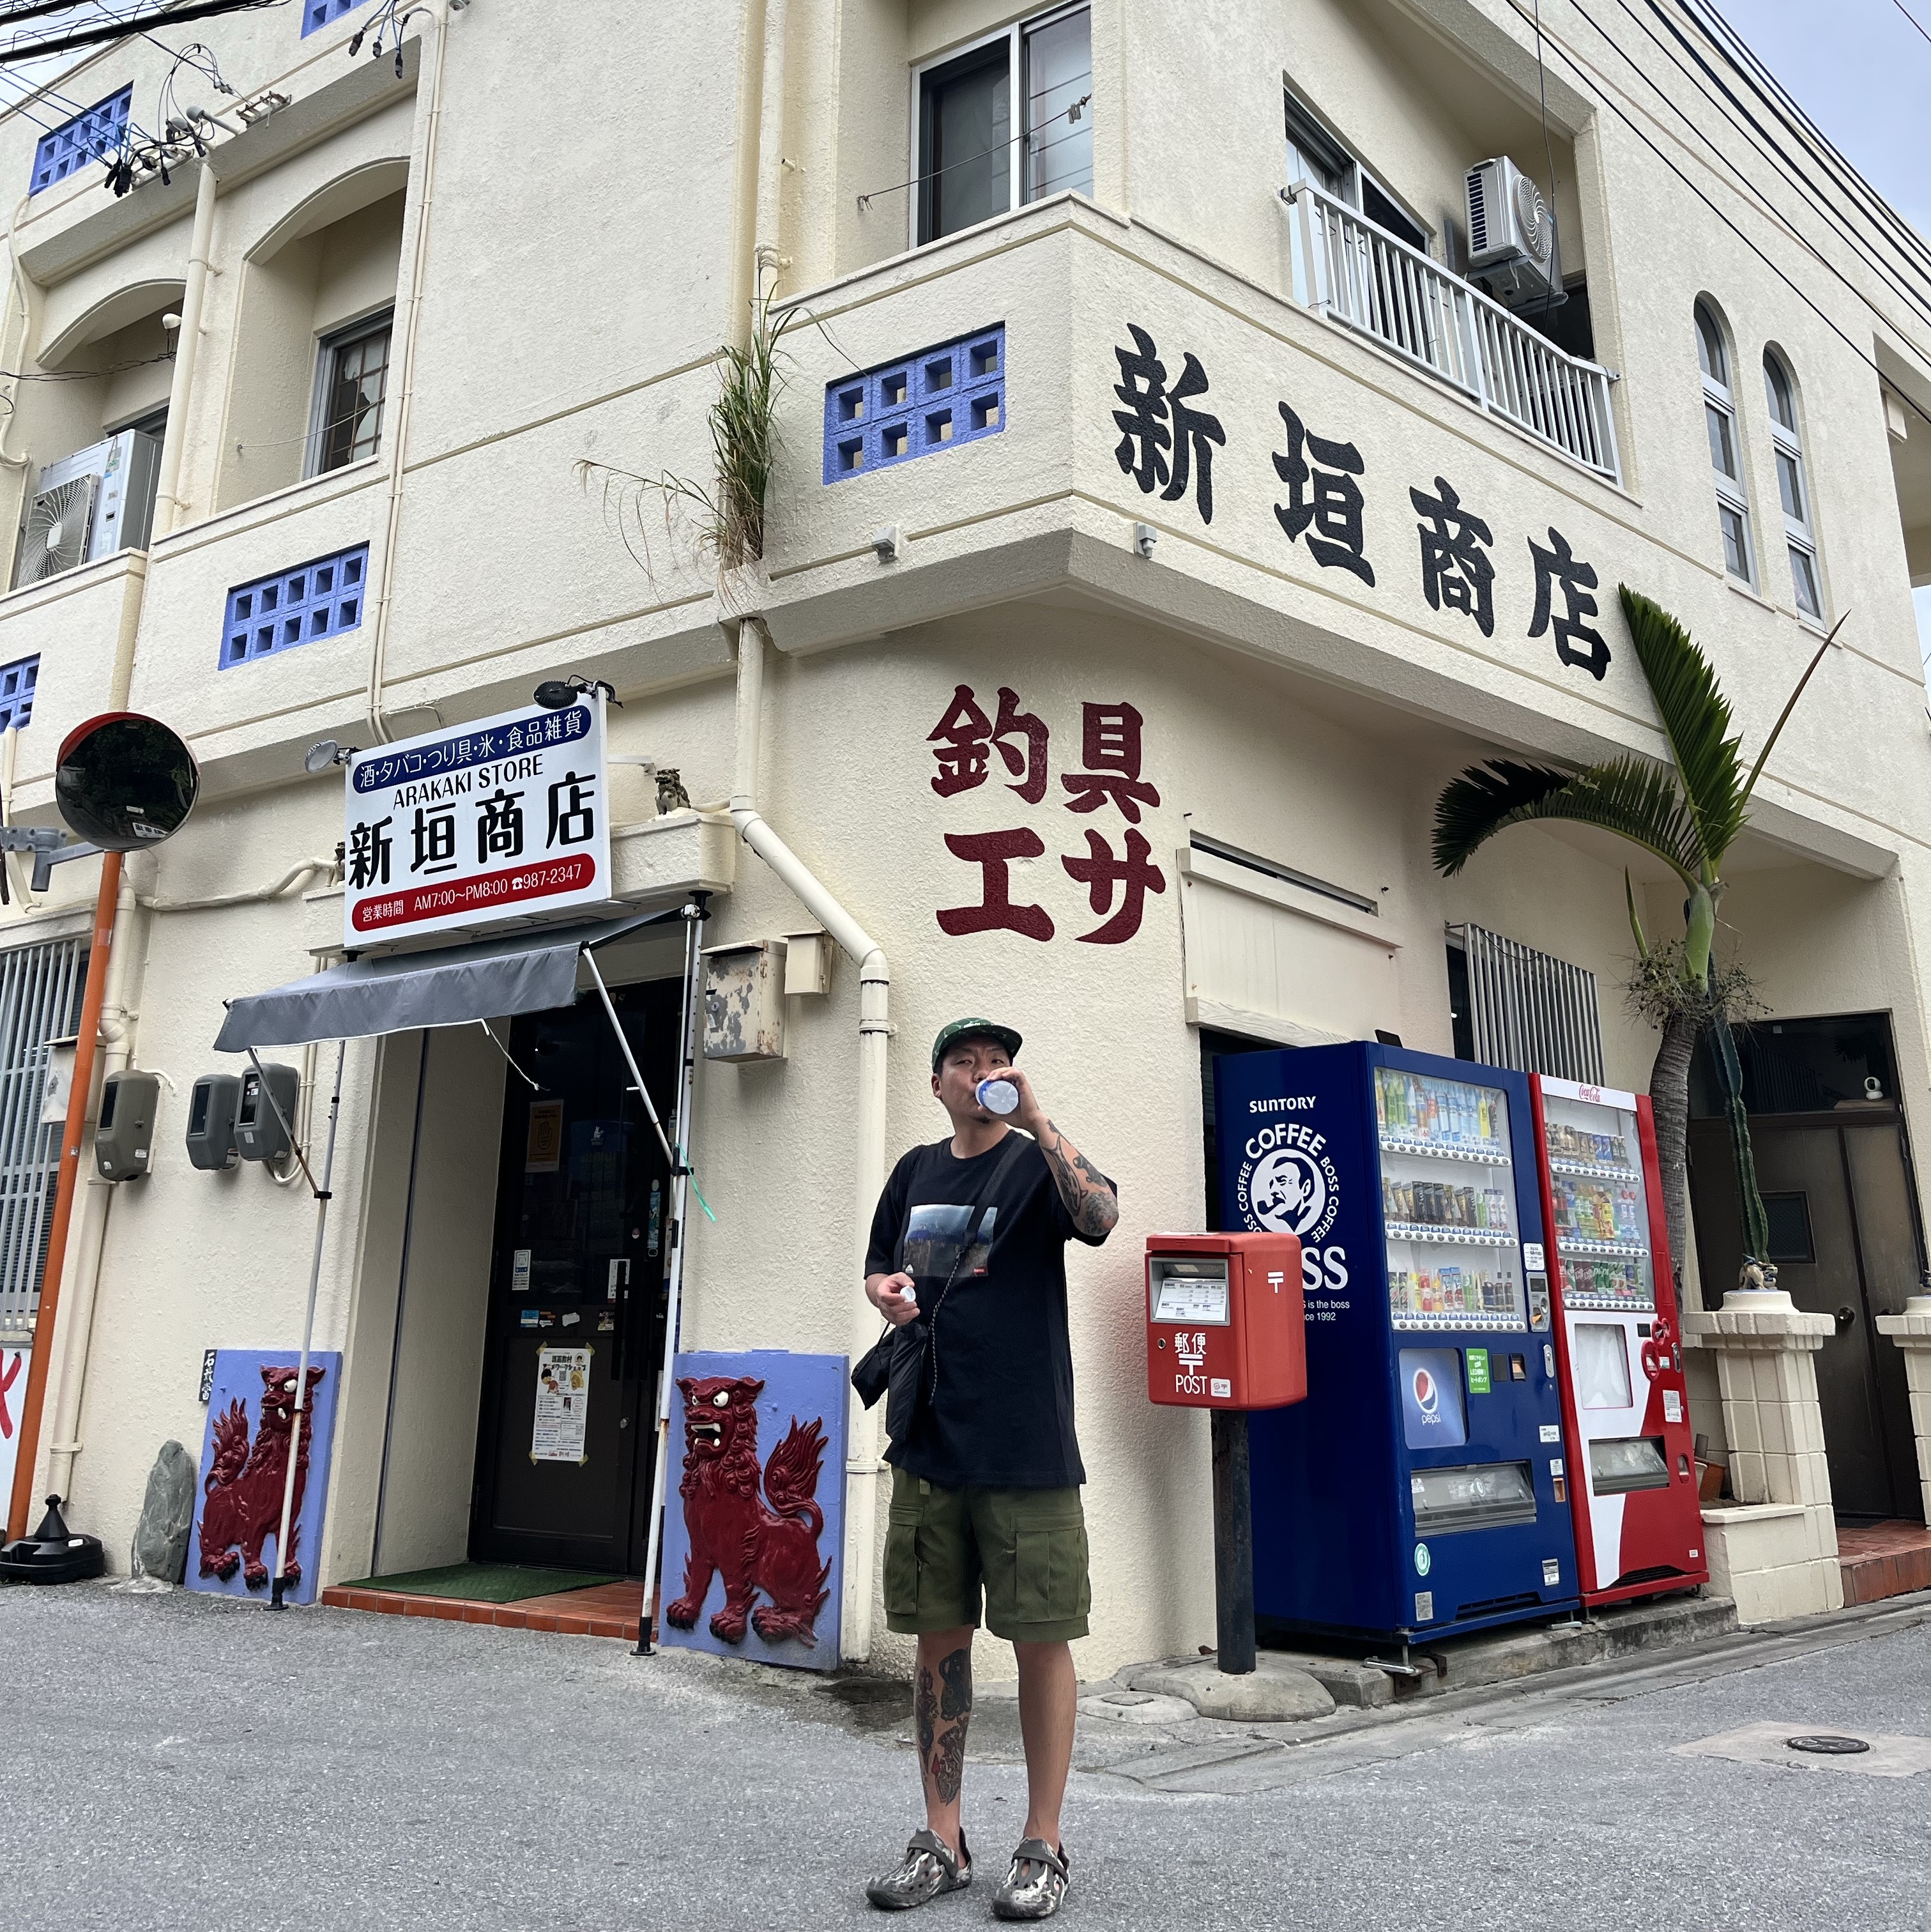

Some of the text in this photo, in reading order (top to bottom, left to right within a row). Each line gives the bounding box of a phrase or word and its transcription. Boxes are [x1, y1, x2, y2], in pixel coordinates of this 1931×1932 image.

[1112, 323, 1611, 681] 新垣商店
[926, 684, 1161, 824] 釣具
[393, 754, 544, 810] ARAKAKI STORE
[348, 771, 596, 890] 新垣商店
[936, 827, 1166, 945] エサ
[362, 899, 404, 922] 営業時間
[1249, 1096, 1317, 1114] SUNTORY
[1246, 1123, 1327, 1159] COFFEE
[1237, 1162, 1253, 1211] COFFEE
[1311, 1156, 1339, 1243] BOSS COFFEE
[1301, 1246, 1348, 1290] SS
[1308, 1300, 1315, 1308] is
[1317, 1300, 1329, 1308] the
[1331, 1300, 1350, 1309] boss
[1317, 1312, 1336, 1321] 1992
[1174, 1332, 1207, 1355] 郵便
[1175, 1374, 1208, 1395] POST
[1421, 1411, 1442, 1426] pepsi
